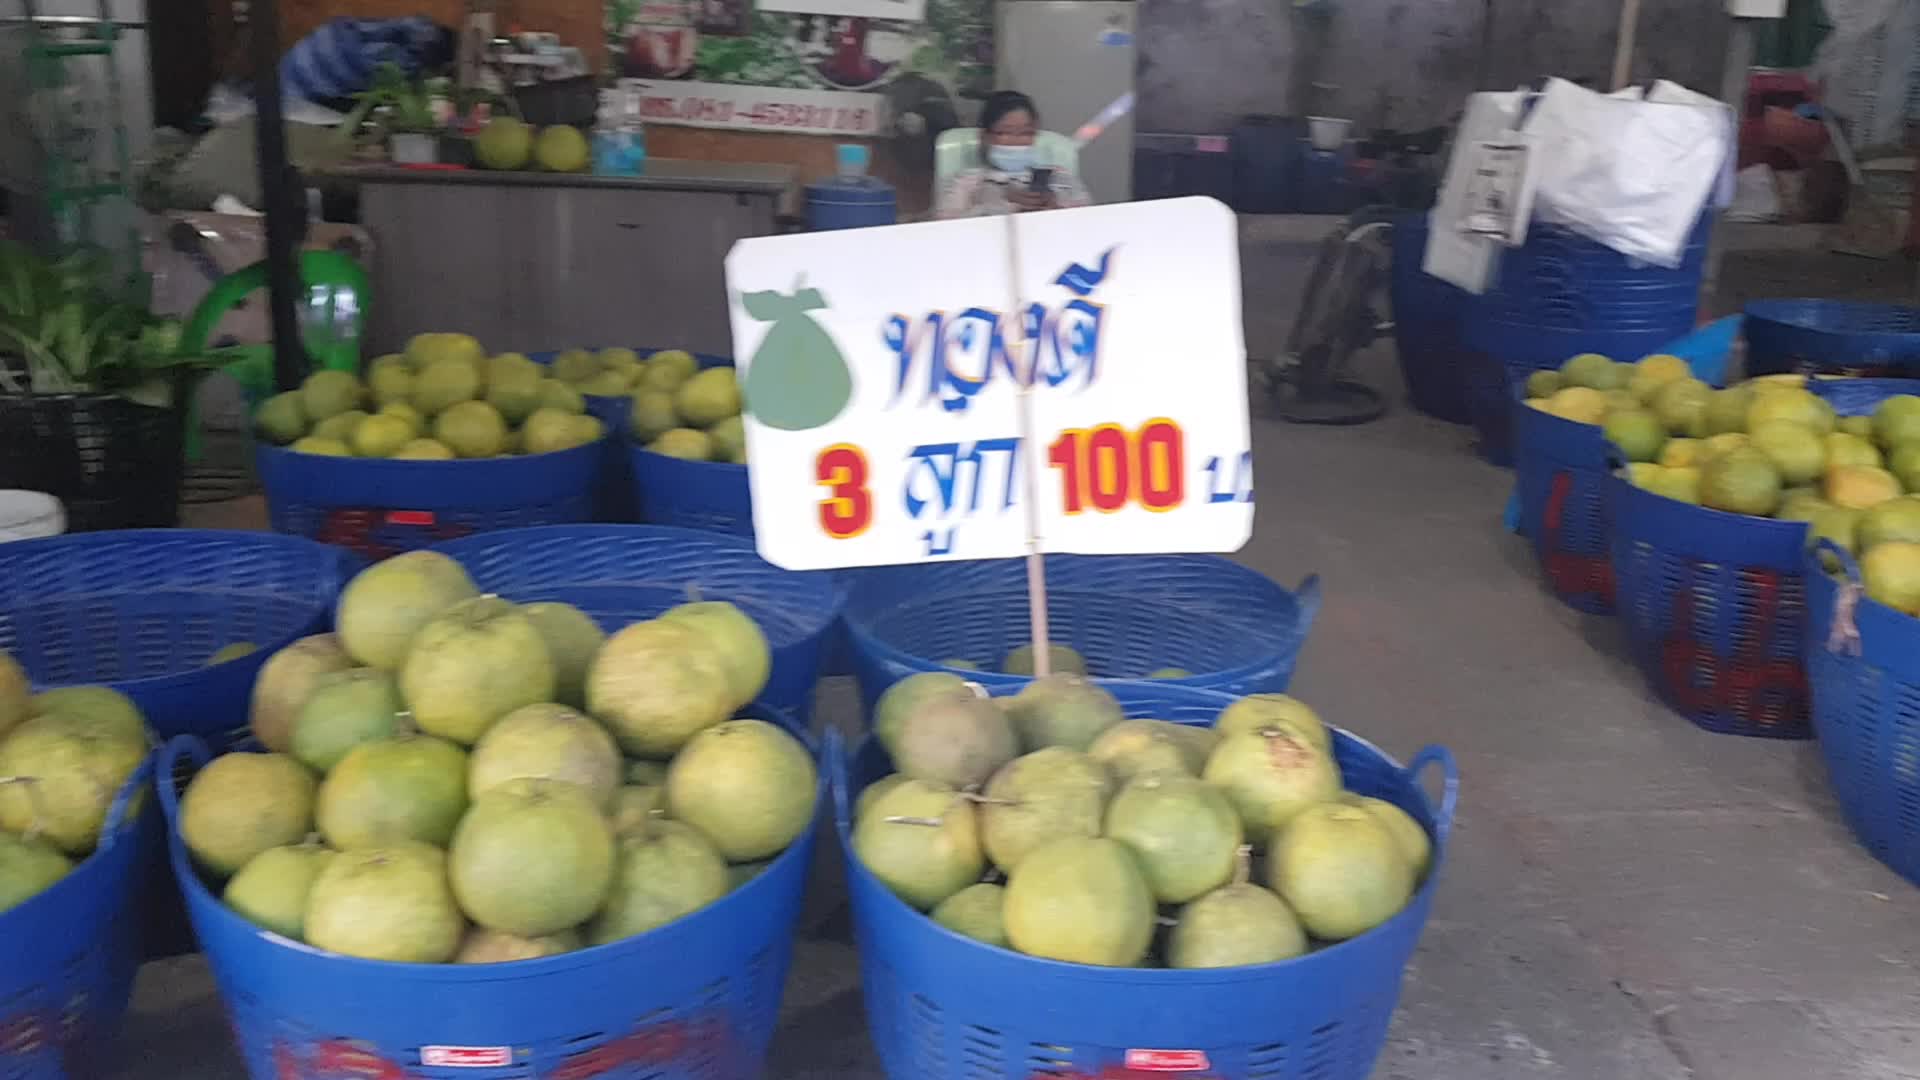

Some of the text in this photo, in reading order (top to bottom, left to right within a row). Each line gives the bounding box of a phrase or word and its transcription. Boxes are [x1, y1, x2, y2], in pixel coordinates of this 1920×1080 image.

[816, 443, 871, 538] 3
[904, 438, 1023, 555] ลูก
[1049, 418, 1183, 514] 100
